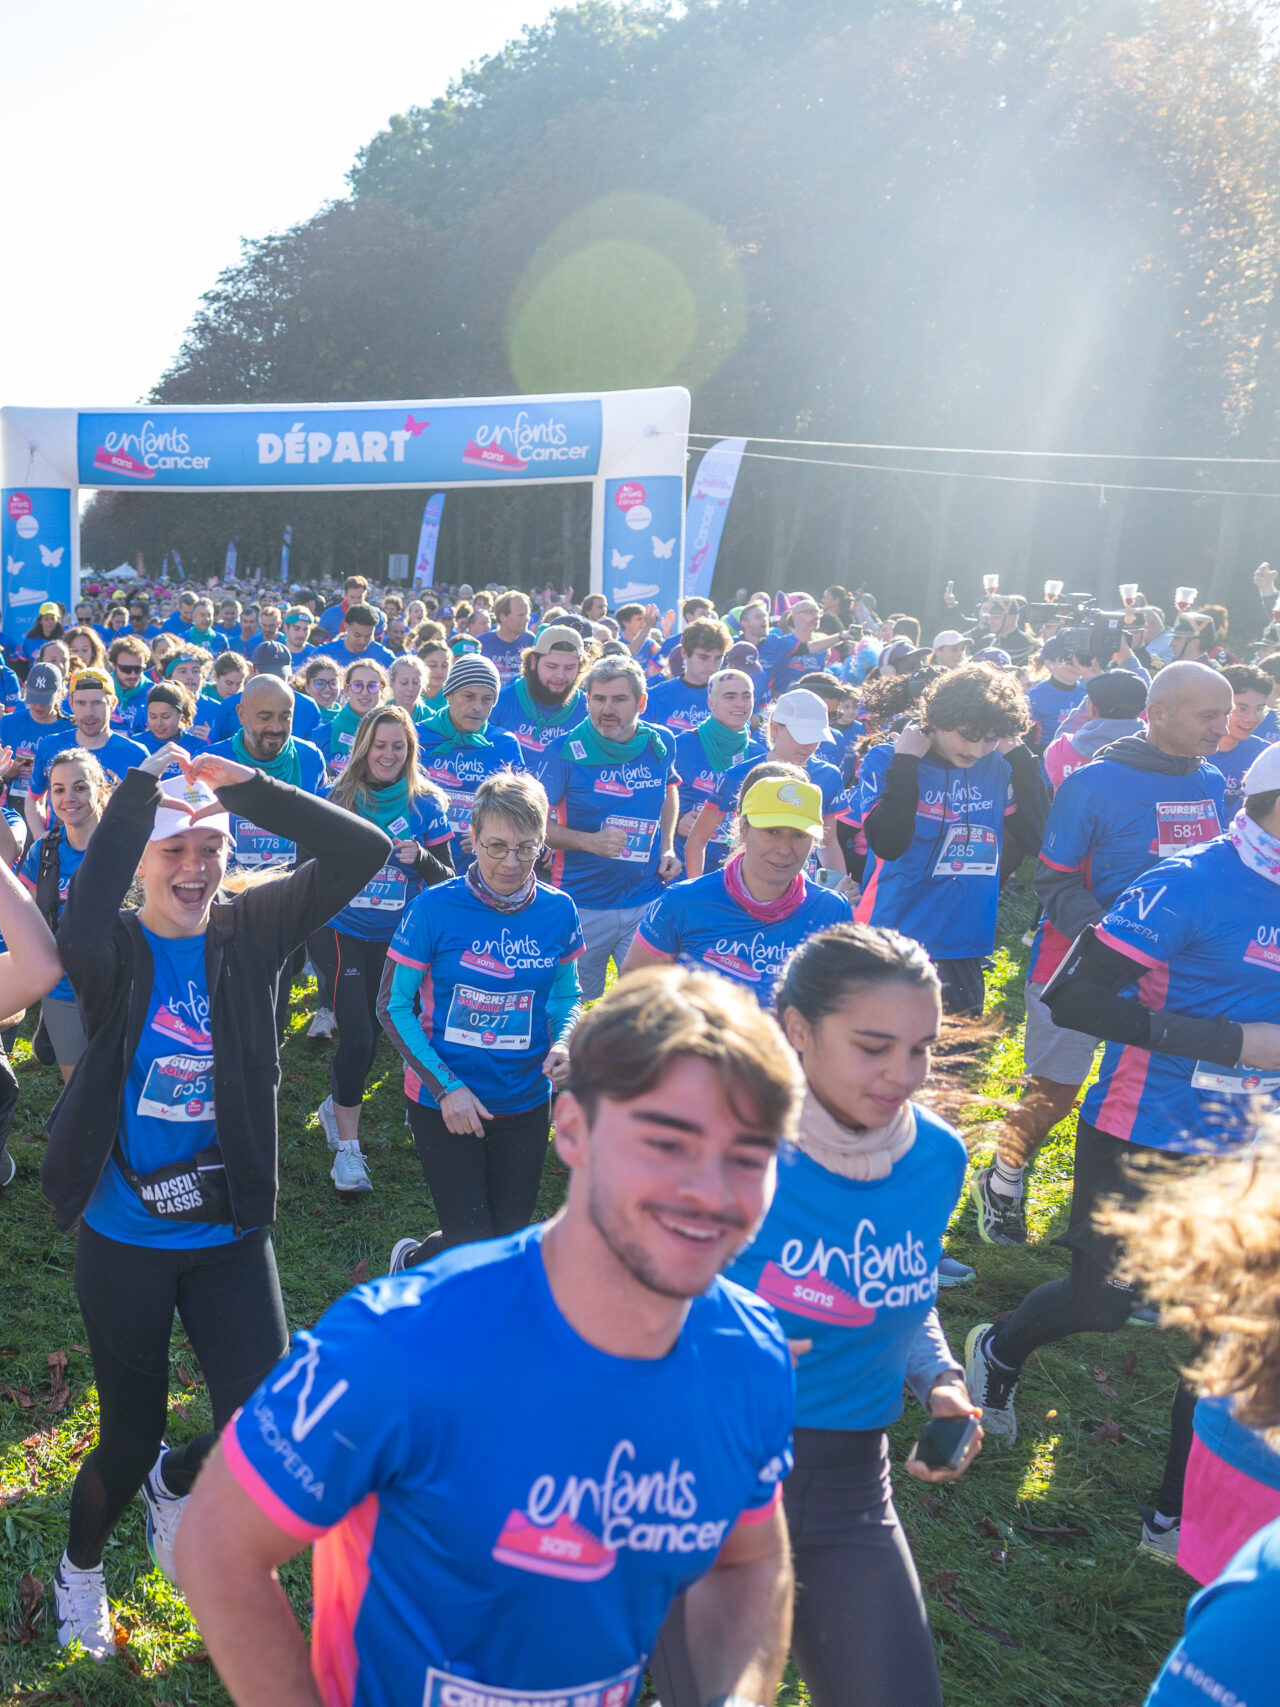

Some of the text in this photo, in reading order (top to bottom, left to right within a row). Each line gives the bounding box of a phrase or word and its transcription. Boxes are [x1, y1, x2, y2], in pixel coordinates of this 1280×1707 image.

[105, 420, 190, 456] enfants
[475, 411, 568, 447] enfants
[257, 422, 413, 465] DÉPART
[517, 444, 590, 463] Cancer
[112, 456, 133, 469] sans
[144, 453, 212, 470] Cancer
[482, 450, 505, 463] sans
[433, 753, 484, 775] enfants
[600, 762, 651, 788] enfants
[457, 771, 491, 783] Cance
[625, 777, 662, 791] Cancer
[252, 838, 280, 849] 1778
[472, 928, 541, 959] enfants
[476, 958, 495, 968] sans
[505, 956, 554, 969] Cancer
[459, 988, 505, 1005] COURONS
[469, 1011, 509, 1029] 0277
[141, 1170, 202, 1201] MARSEIL
[156, 1189, 204, 1214] CASSIS
[780, 1218, 928, 1285] enfants
[792, 1282, 835, 1309] sans
[859, 1270, 938, 1309] Cance
[526, 1439, 698, 1529] enfants
[603, 1515, 729, 1552] Cancer
[538, 1535, 583, 1560] sans
